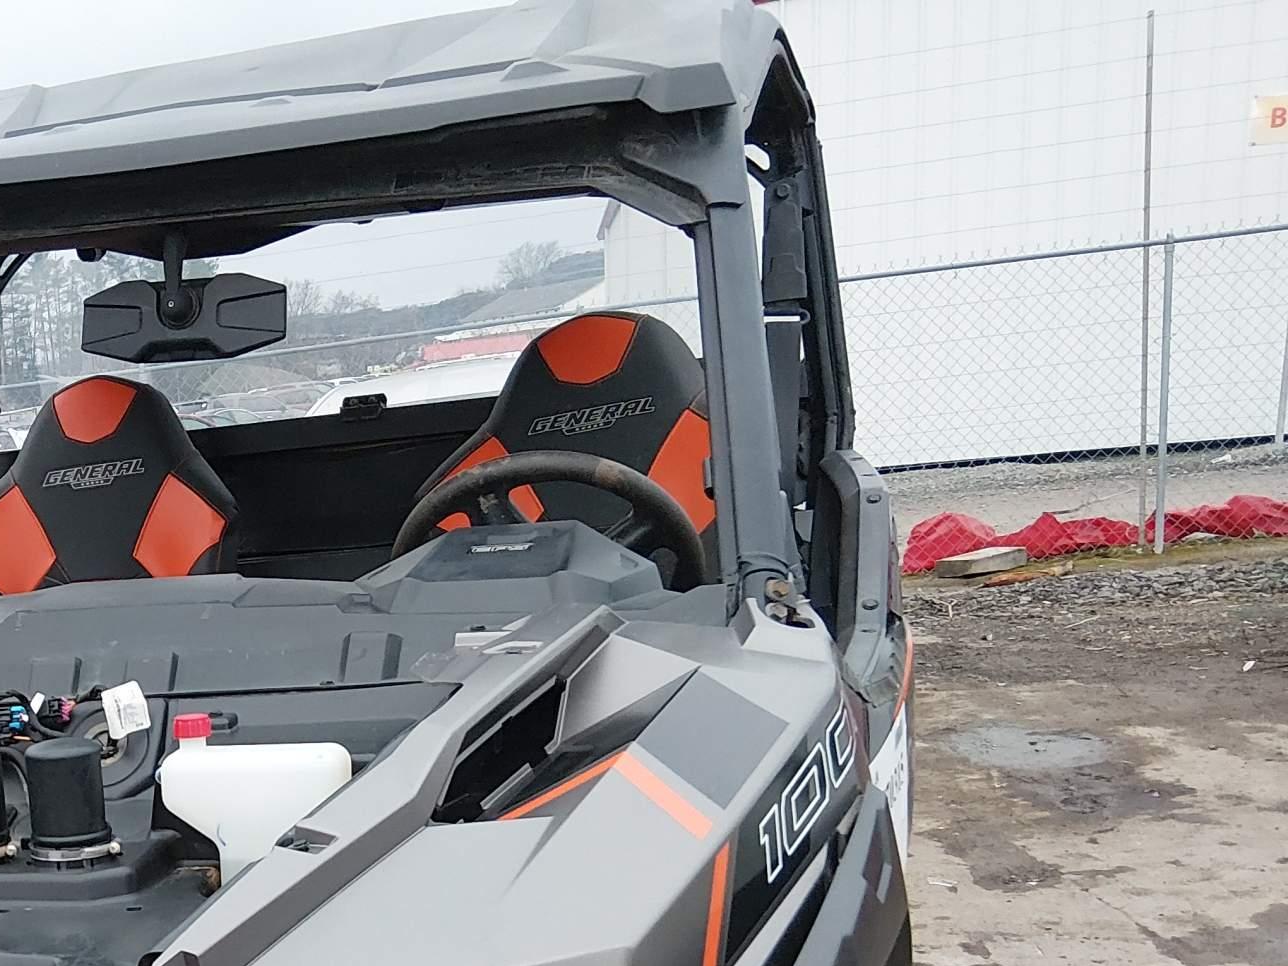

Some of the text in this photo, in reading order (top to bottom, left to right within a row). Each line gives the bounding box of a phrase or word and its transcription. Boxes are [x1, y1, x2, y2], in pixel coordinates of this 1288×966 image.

[1270, 106, 1287, 129] B
[528, 397, 655, 435] GENERAL
[43, 459, 145, 487] GENERAL
